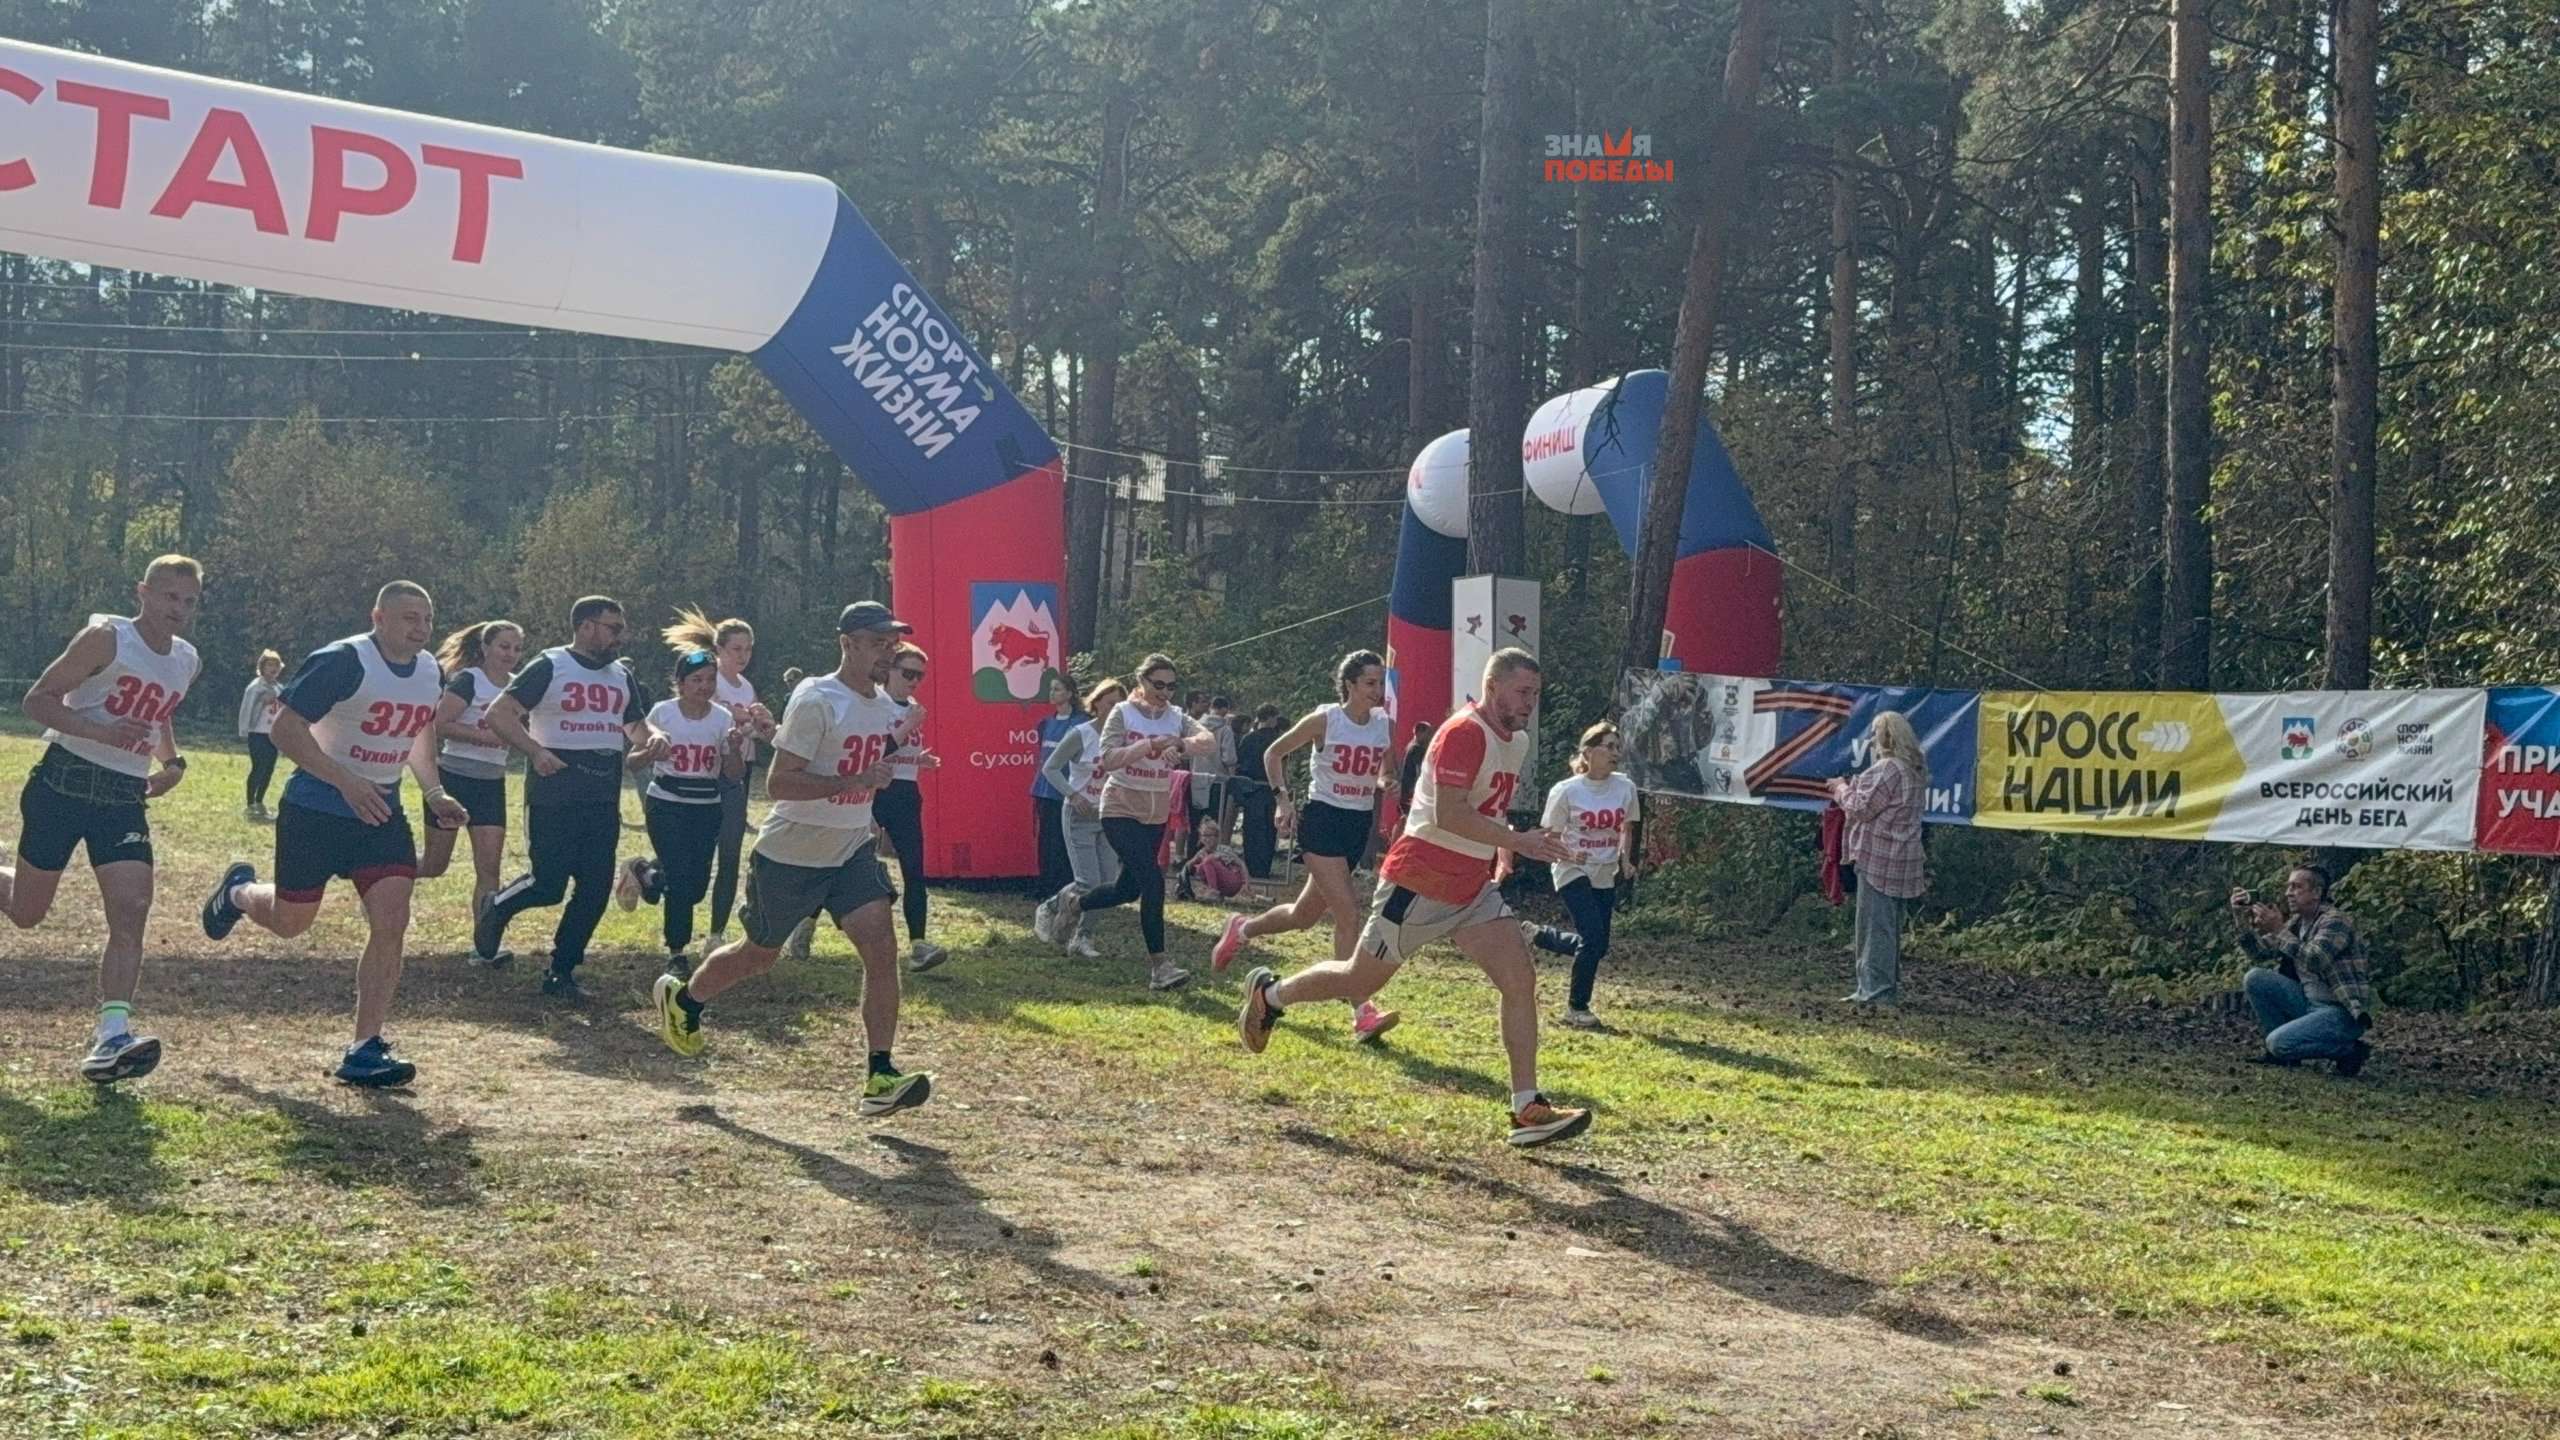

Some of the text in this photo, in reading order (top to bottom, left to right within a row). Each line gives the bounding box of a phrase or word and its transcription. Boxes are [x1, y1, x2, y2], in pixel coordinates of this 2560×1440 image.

[891, 282, 980, 384] СПОРТ
[861, 301, 982, 434] НОРМА
[829, 327, 955, 460] ЖИЗНИ
[1523, 425, 1576, 464] ФИНИШ
[560, 682, 624, 715] 397
[361, 700, 437, 738] 378
[560, 719, 606, 733] Сухой
[2006, 710, 2140, 761] КРОСС
[349, 744, 398, 764] Сухой
[670, 743, 718, 772] 376
[969, 750, 1035, 770] Сухой
[1332, 744, 1384, 776] 365
[2003, 765, 2181, 820] НАЦИИ
[2260, 777, 2454, 803] ВСЕРОССИЙСКИЙ
[2295, 807, 2408, 828] ДЕНЬ БЕГА
